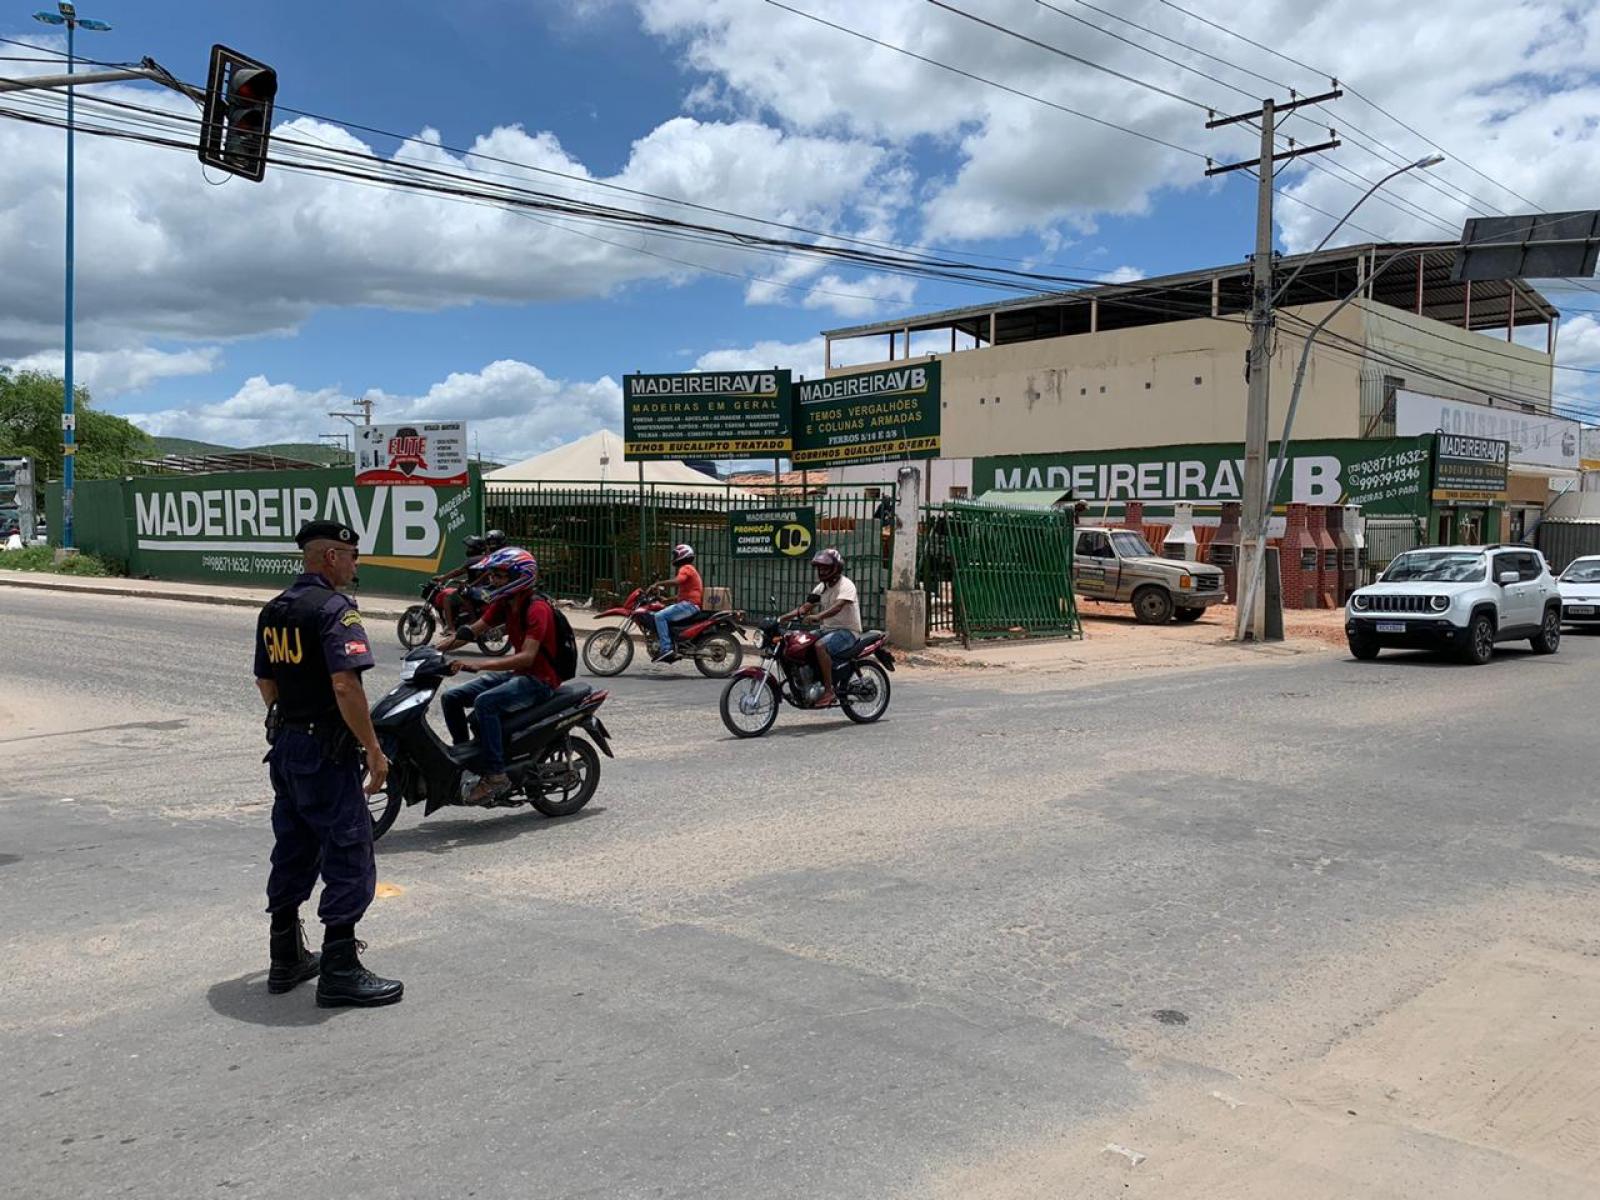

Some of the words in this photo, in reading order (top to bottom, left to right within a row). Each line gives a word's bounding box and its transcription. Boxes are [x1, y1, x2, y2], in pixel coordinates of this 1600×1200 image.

[631, 374, 777, 394] MADEIREIRAVB
[800, 368, 926, 401] MADEIREIRAVB
[632, 400, 700, 413] MADEIRAS
[708, 400, 726, 411] EM
[734, 399, 777, 410] GERAL
[809, 409, 842, 422] TEMOS
[848, 398, 918, 417] VERGALHÕES
[806, 425, 814, 434] E
[818, 418, 865, 434] COLUNAS
[870, 411, 923, 427] ARMADAS
[388, 436, 427, 456] ELITE
[629, 443, 665, 452] TEMOS
[669, 441, 730, 451] EUCALIPTO
[735, 440, 785, 450] TRATADO
[794, 448, 841, 461] COBRIMOS
[844, 443, 895, 456] QUALQUER
[450, 508, 459, 520] DO
[734, 523, 774, 533] PROMOÇÃO
[738, 536, 771, 544] CIMENTO
[736, 545, 774, 554] NACIONAL
[263, 626, 303, 664] GMJ
